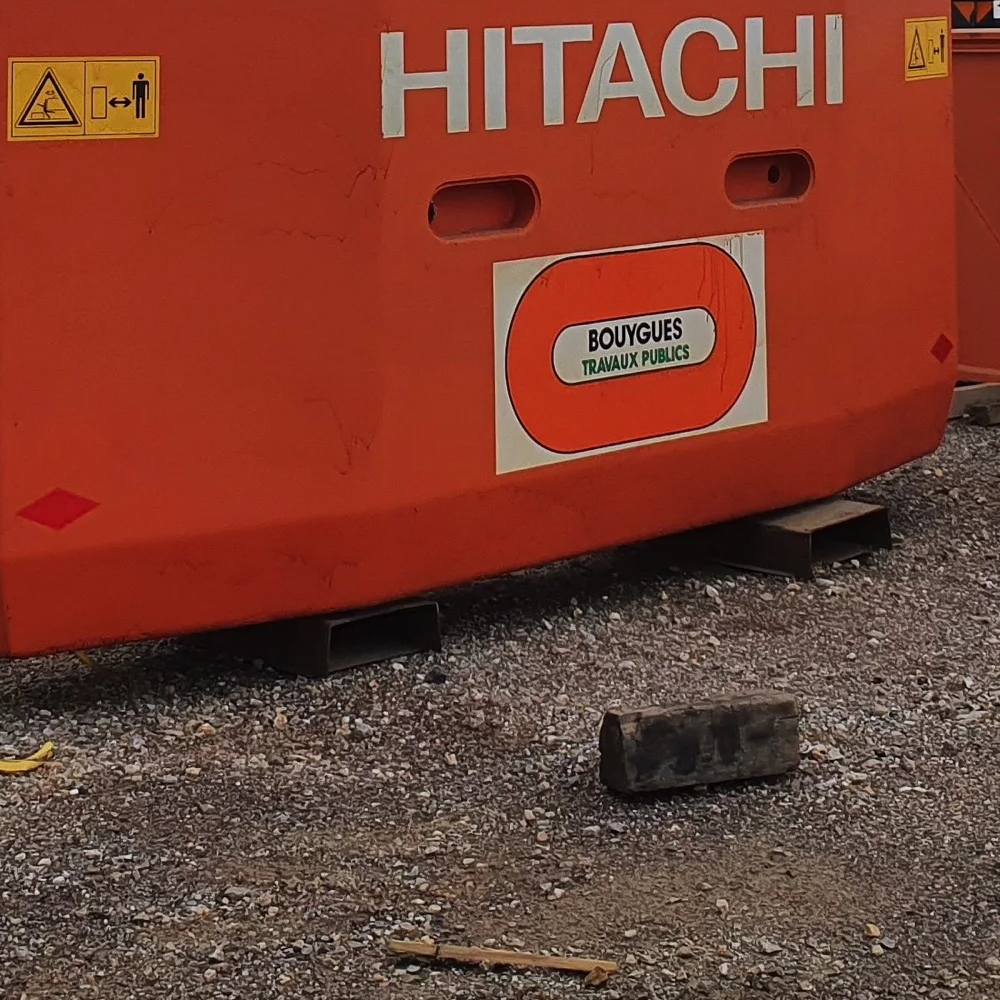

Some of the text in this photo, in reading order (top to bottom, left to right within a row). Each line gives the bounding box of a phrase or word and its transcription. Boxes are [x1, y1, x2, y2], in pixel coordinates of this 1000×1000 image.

[380, 14, 844, 138] HITACHI
[588, 317, 683, 352] BOUYGUES
[582, 344, 690, 376] TRAVAUX PUBLICS
